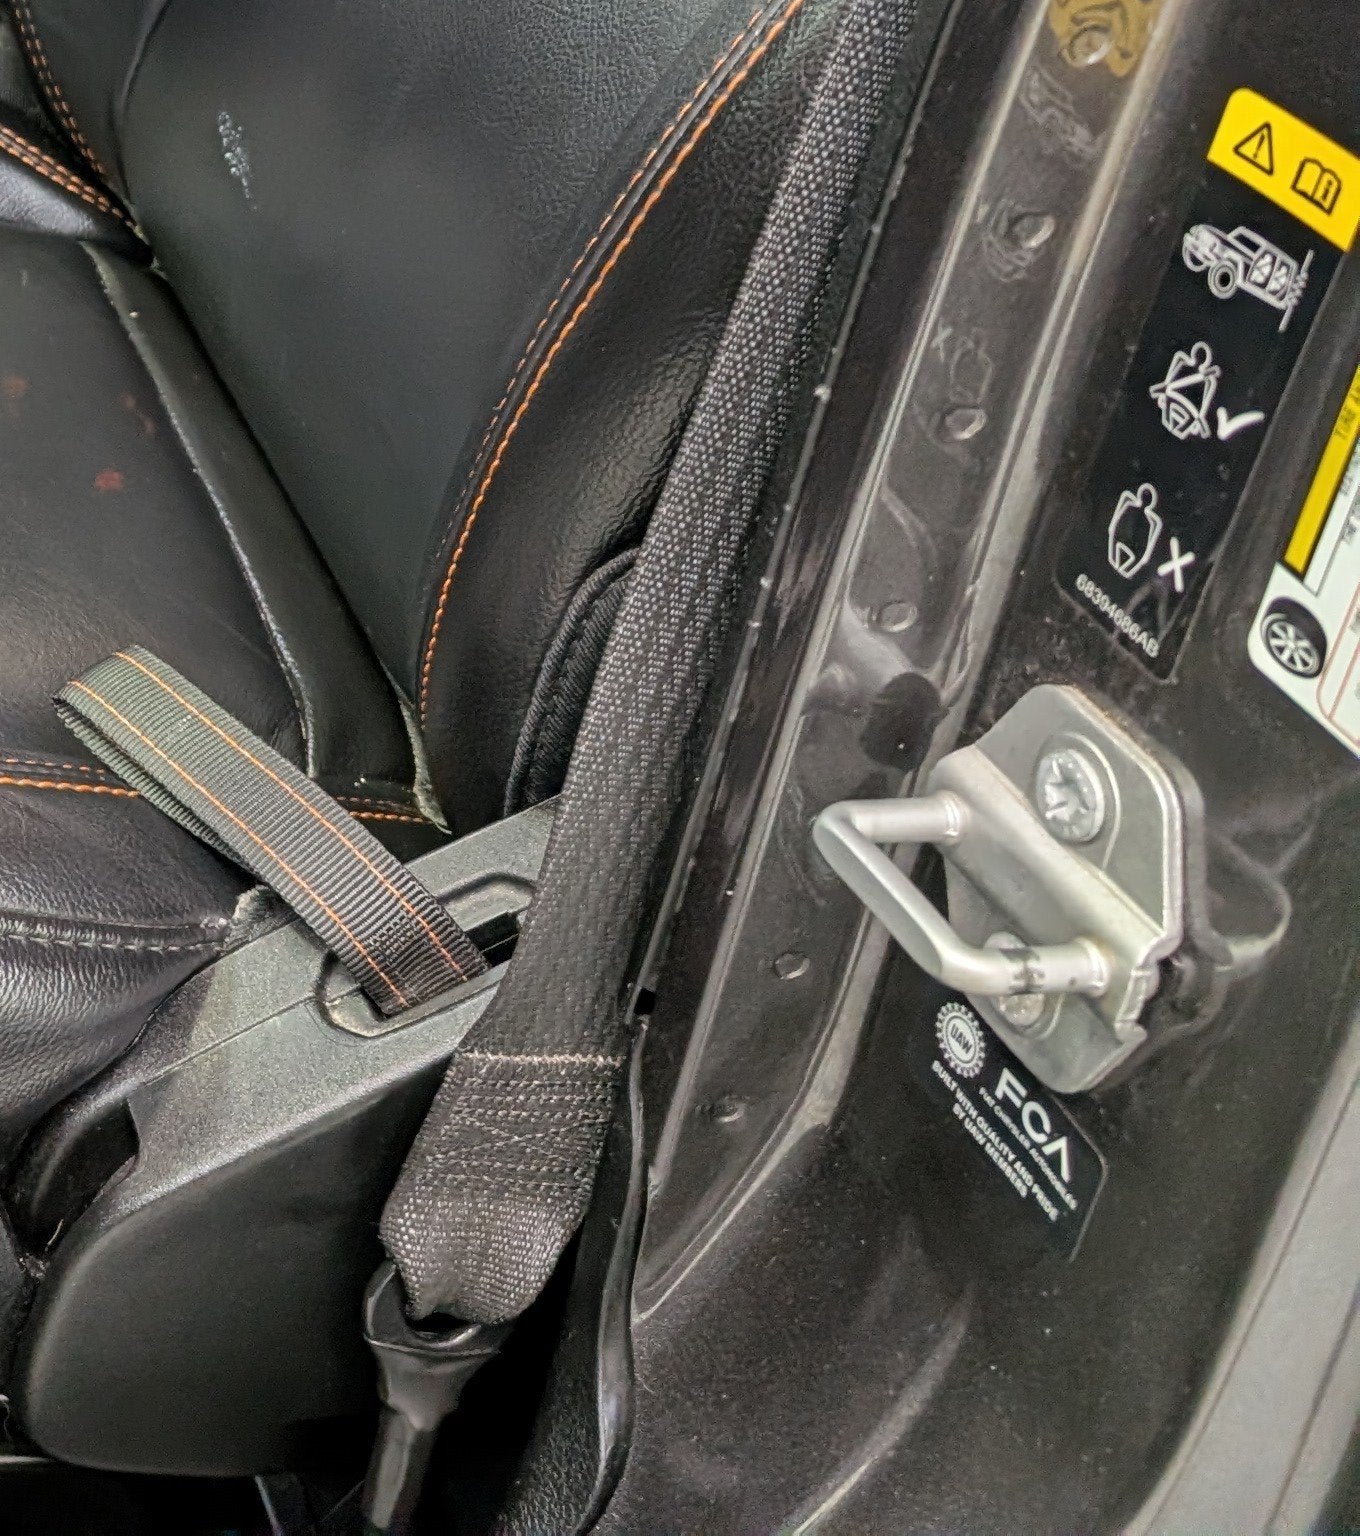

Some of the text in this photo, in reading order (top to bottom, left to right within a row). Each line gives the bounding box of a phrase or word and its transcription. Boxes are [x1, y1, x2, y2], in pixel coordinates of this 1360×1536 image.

[951, 1023, 972, 1054] UAW
[931, 1060, 1059, 1222] BUILT WITH QUALITY AND PRIDE
[952, 1102, 1028, 1198] BY UAW MEMBERS
[994, 1066, 1071, 1183] FCA
